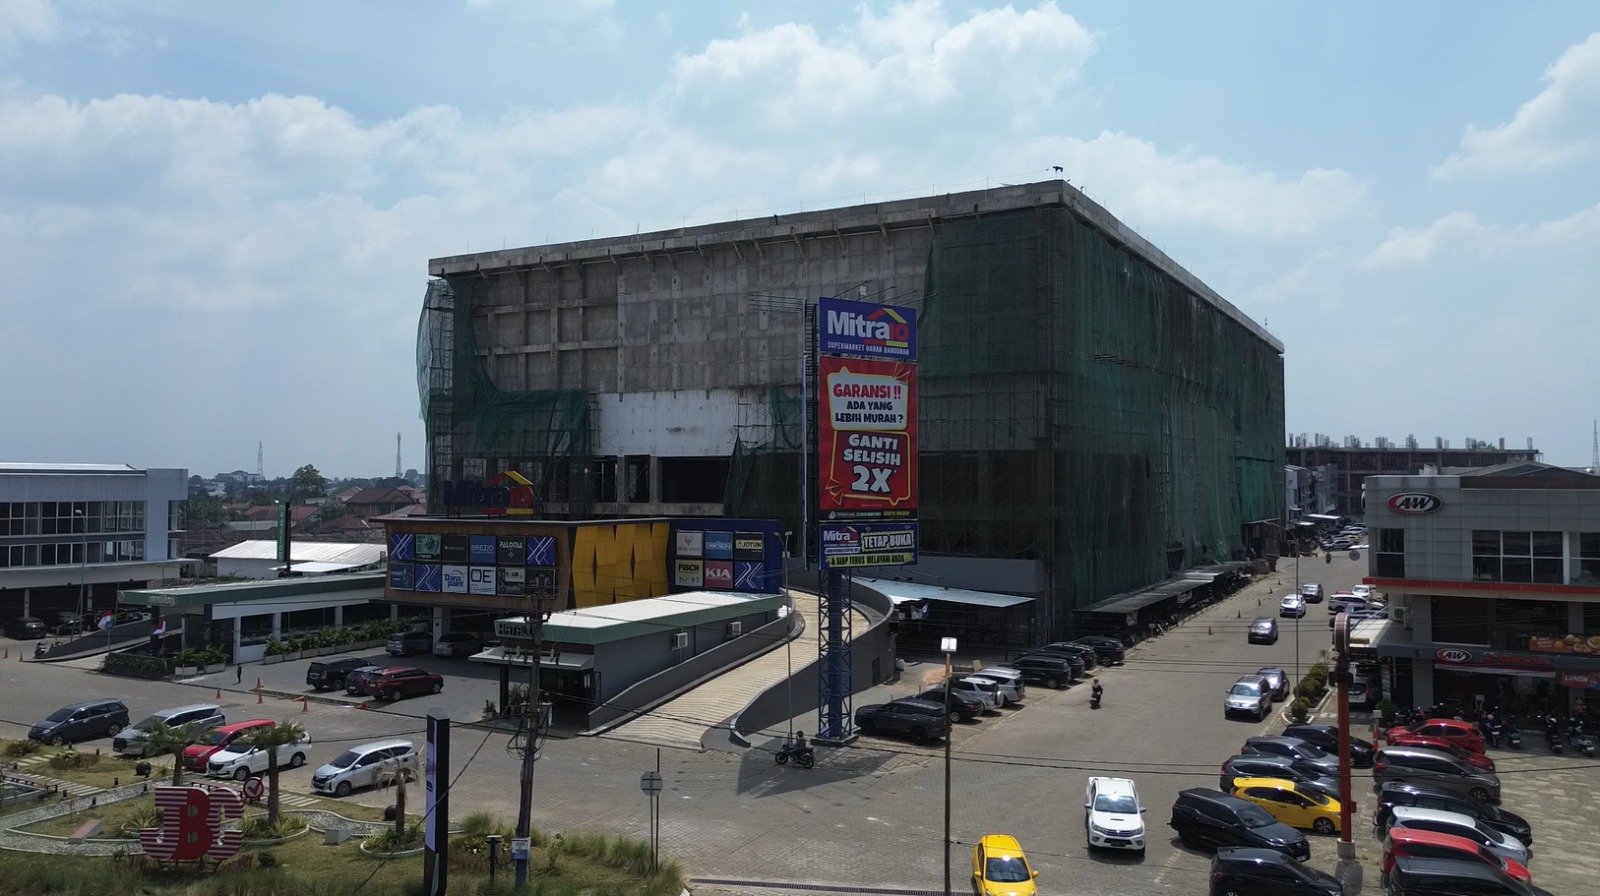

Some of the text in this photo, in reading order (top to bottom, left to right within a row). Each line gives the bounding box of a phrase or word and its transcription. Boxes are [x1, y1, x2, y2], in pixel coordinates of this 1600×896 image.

[827, 310, 909, 341] Mitra10
[833, 383, 891, 399] GARANSI
[846, 401, 893, 411] ADA YANG
[835, 413, 861, 423] LEBIH
[863, 414, 896, 423] MURAH
[848, 434, 898, 450] GANTI
[843, 449, 901, 465] SELISIH
[863, 533, 912, 549] TETAP BUKA
[678, 564, 699, 572] FISCH
[836, 557, 848, 566] SIAP
[849, 556, 865, 565] TERUS
[471, 569, 492, 583] OE
[705, 568, 731, 578] KIA
